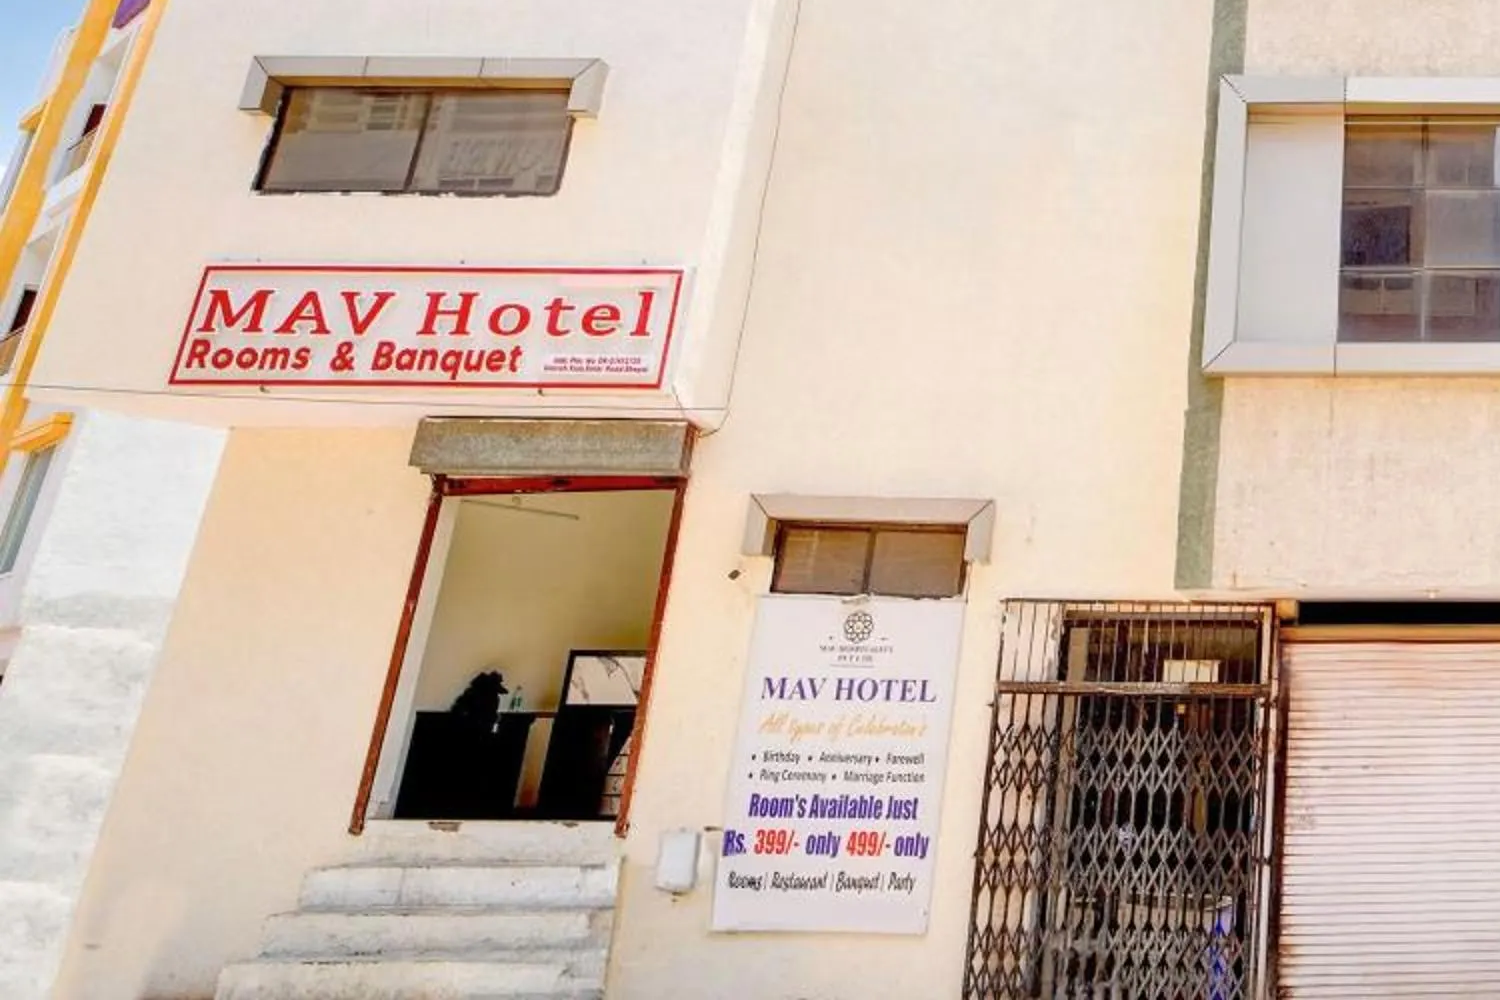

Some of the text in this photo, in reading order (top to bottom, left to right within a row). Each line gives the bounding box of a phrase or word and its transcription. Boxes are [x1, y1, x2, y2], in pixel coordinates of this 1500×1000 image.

[196, 289, 655, 337] MAV Hotel
[185, 339, 522, 380] Rooms & Banquet
[761, 676, 937, 703] MAV HOTEL
[762, 750, 925, 766] Birthday Anniversary Farewell
[759, 768, 925, 785] Ring Ceremony Marriage Function
[749, 793, 919, 821] Room's Available Just
[722, 829, 930, 860] Rs. 399/- only 499/- only
[770, 871, 829, 893] Restaurant
[835, 872, 880, 894] Banquet
[887, 872, 917, 895] Party
